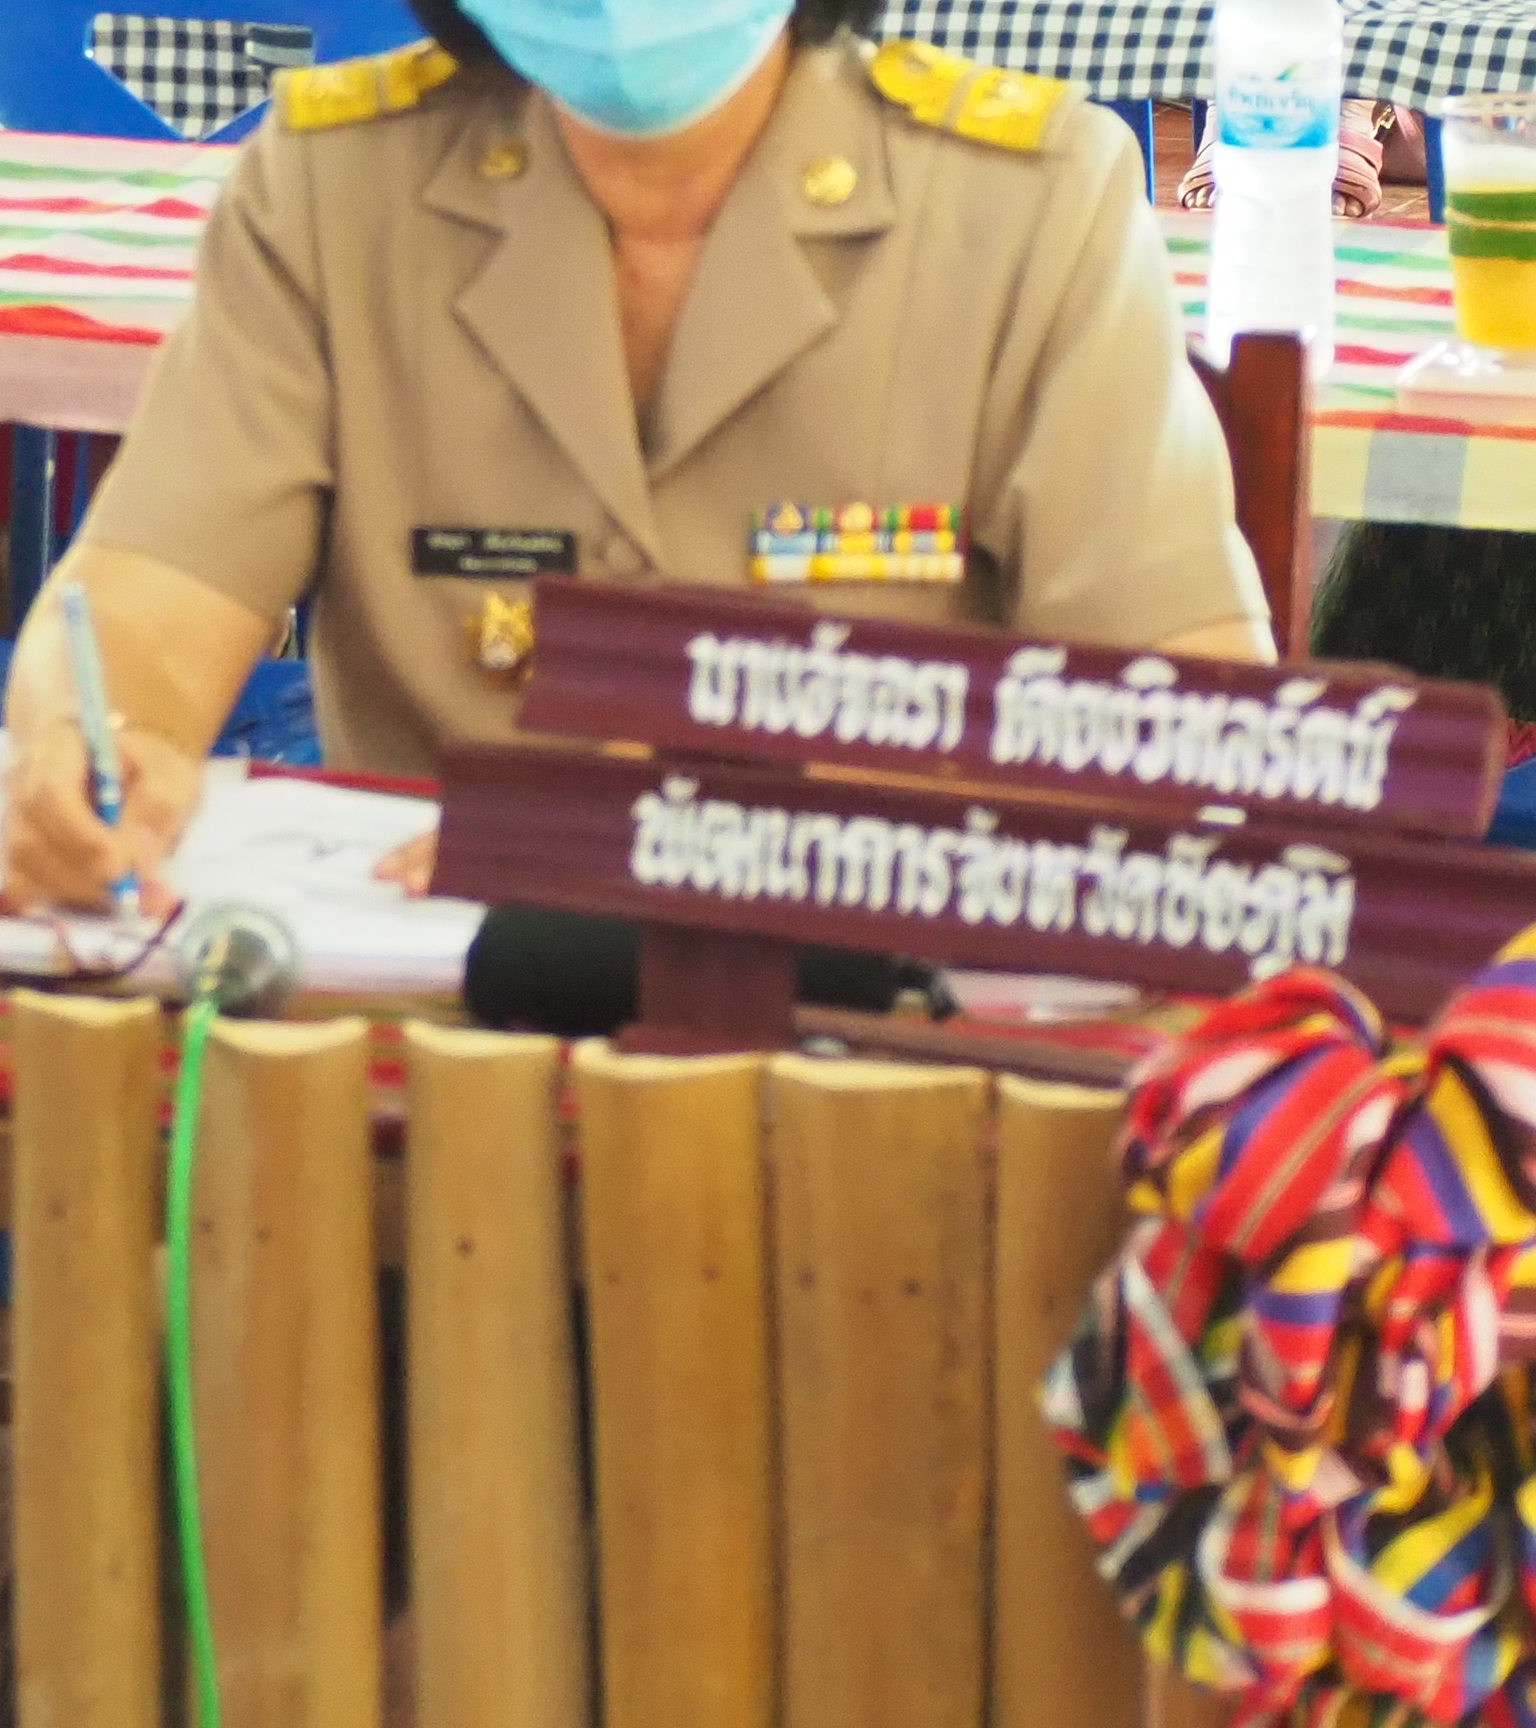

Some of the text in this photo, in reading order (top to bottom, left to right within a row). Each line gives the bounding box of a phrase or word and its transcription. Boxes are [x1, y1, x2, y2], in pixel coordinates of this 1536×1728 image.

[631, 774, 1357, 981] พัฒนาการจังหวัดชัยภูมิ
